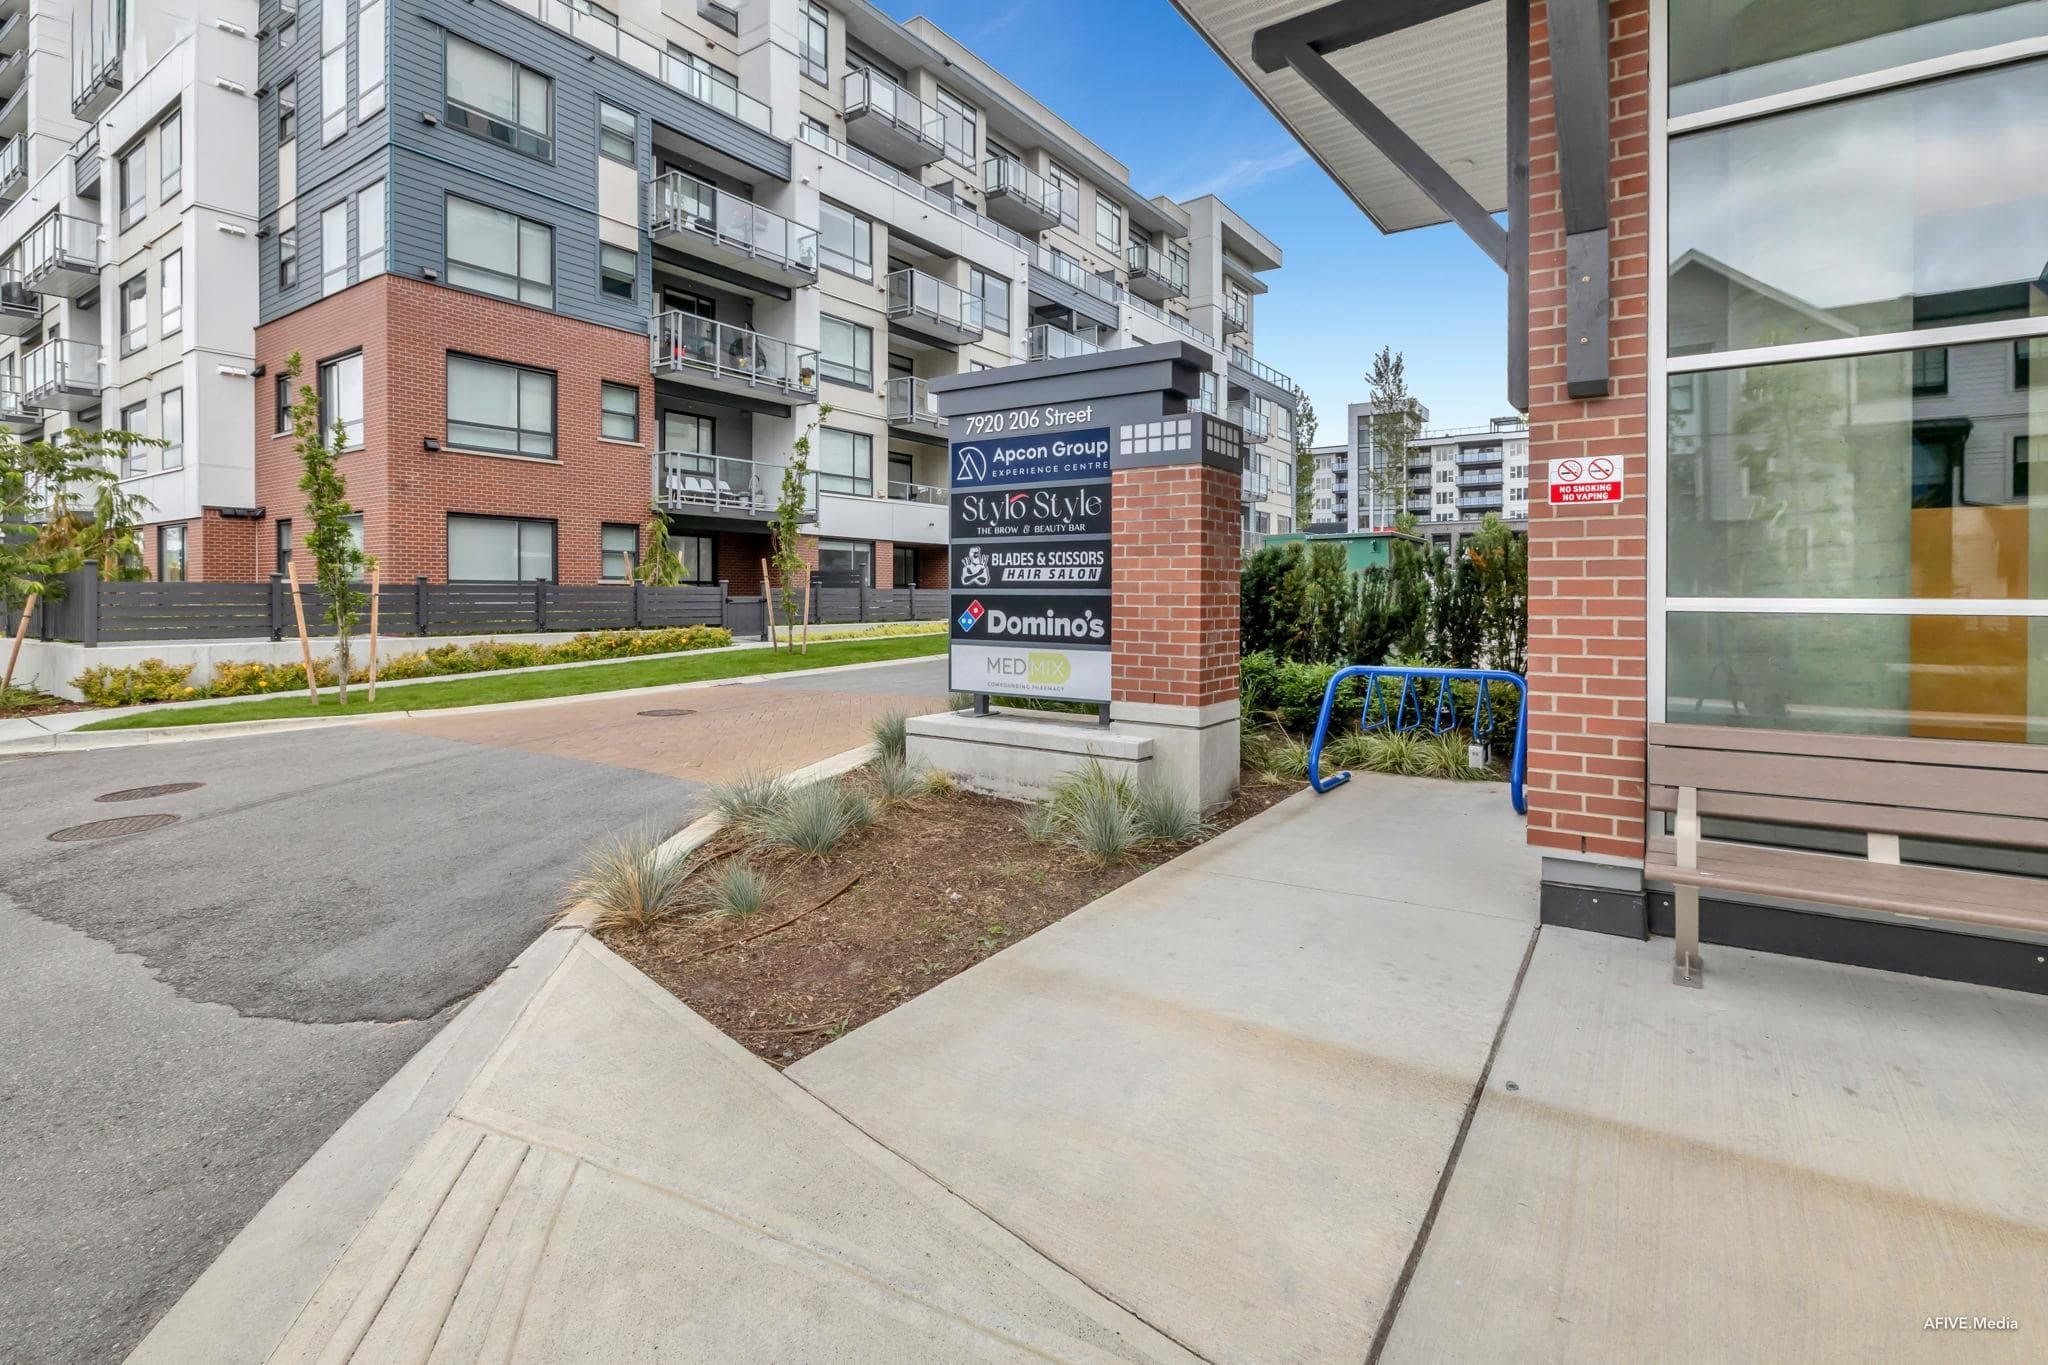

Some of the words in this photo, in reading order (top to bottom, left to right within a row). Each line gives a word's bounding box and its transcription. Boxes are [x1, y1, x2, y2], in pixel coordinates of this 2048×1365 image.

[966, 414, 1004, 435] 7920
[1009, 409, 1039, 430] 206
[1045, 405, 1093, 426] Street
[992, 447, 1047, 465] Apcon
[1052, 441, 1108, 457] Group
[992, 465, 1059, 477] EXPERIENCE
[1064, 461, 1108, 472] CENTRE
[1573, 484, 1612, 492] SMOKING
[1576, 492, 1608, 500] VAPING
[1033, 488, 1102, 523] Style
[977, 527, 992, 535] THE
[994, 526, 1018, 534] BROW
[1023, 525, 1030, 533] &
[1034, 525, 1066, 533] BEAUTY
[991, 553, 1034, 566] BLADES
[1036, 553, 1046, 565] &
[1048, 551, 1104, 565] SCISSORS
[1007, 569, 1041, 579] HAIR
[1049, 569, 1097, 579] SALON
[987, 609, 1105, 638] Domino's
[987, 657, 1027, 675] MED
[1030, 660, 1064, 677] MIX
[987, 682, 1030, 690] COMPOUNDING
